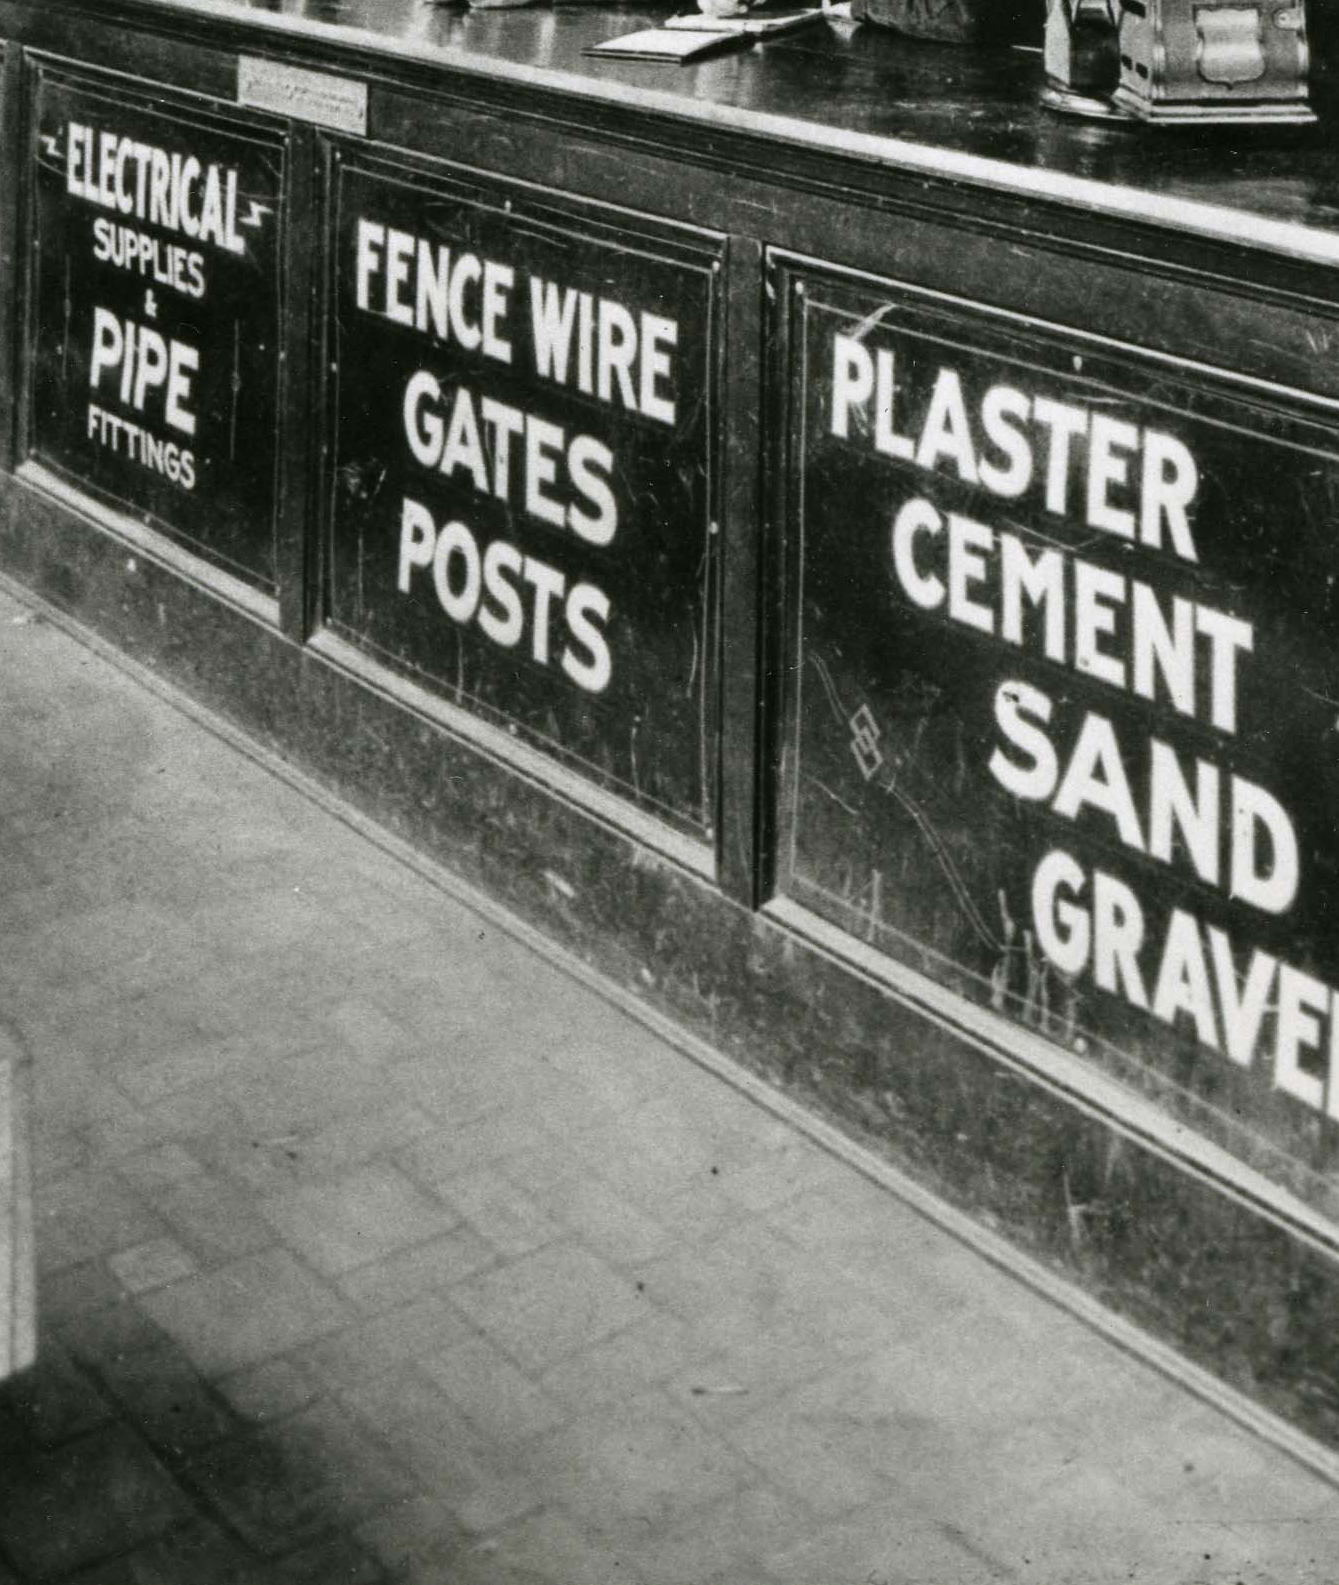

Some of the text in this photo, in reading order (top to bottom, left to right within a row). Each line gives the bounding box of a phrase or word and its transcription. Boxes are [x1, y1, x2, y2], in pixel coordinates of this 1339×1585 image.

[67, 121, 247, 256] ELECTRICAL
[92, 217, 206, 299] SUPPLIES
[90, 306, 200, 435] PIPE
[145, 289, 159, 317] &
[356, 217, 679, 426] FENCE WIRE
[87, 404, 197, 492] FITTINGS
[404, 370, 620, 547] GATES
[829, 332, 1200, 564] PLASTER
[397, 497, 613, 694] POSTS
[891, 498, 1254, 735] CEMENT
[988, 679, 1301, 916] SAND
